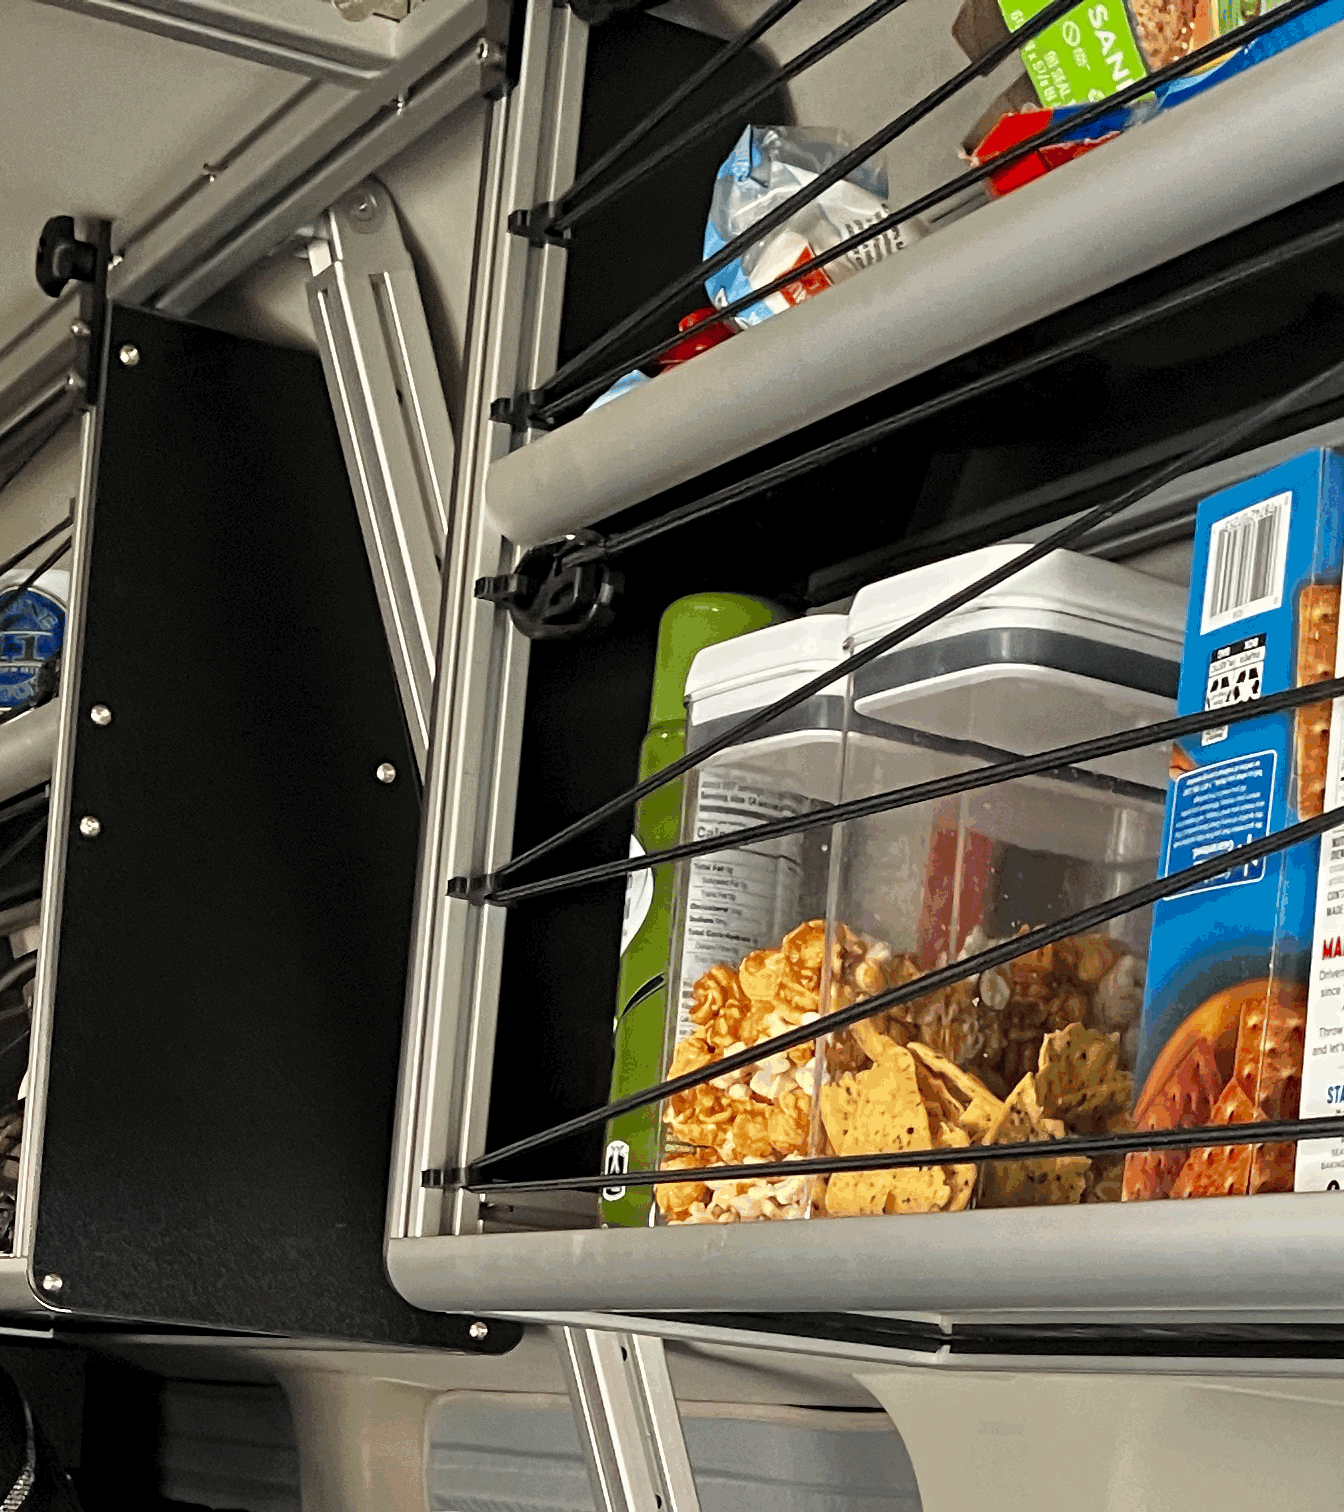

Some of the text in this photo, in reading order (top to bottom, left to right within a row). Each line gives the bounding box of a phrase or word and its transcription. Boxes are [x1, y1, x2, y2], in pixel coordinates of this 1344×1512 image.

[1321, 986, 1341, 998] since
[1319, 1026, 1343, 1038] Throw
[1312, 1045, 1327, 1056] and
